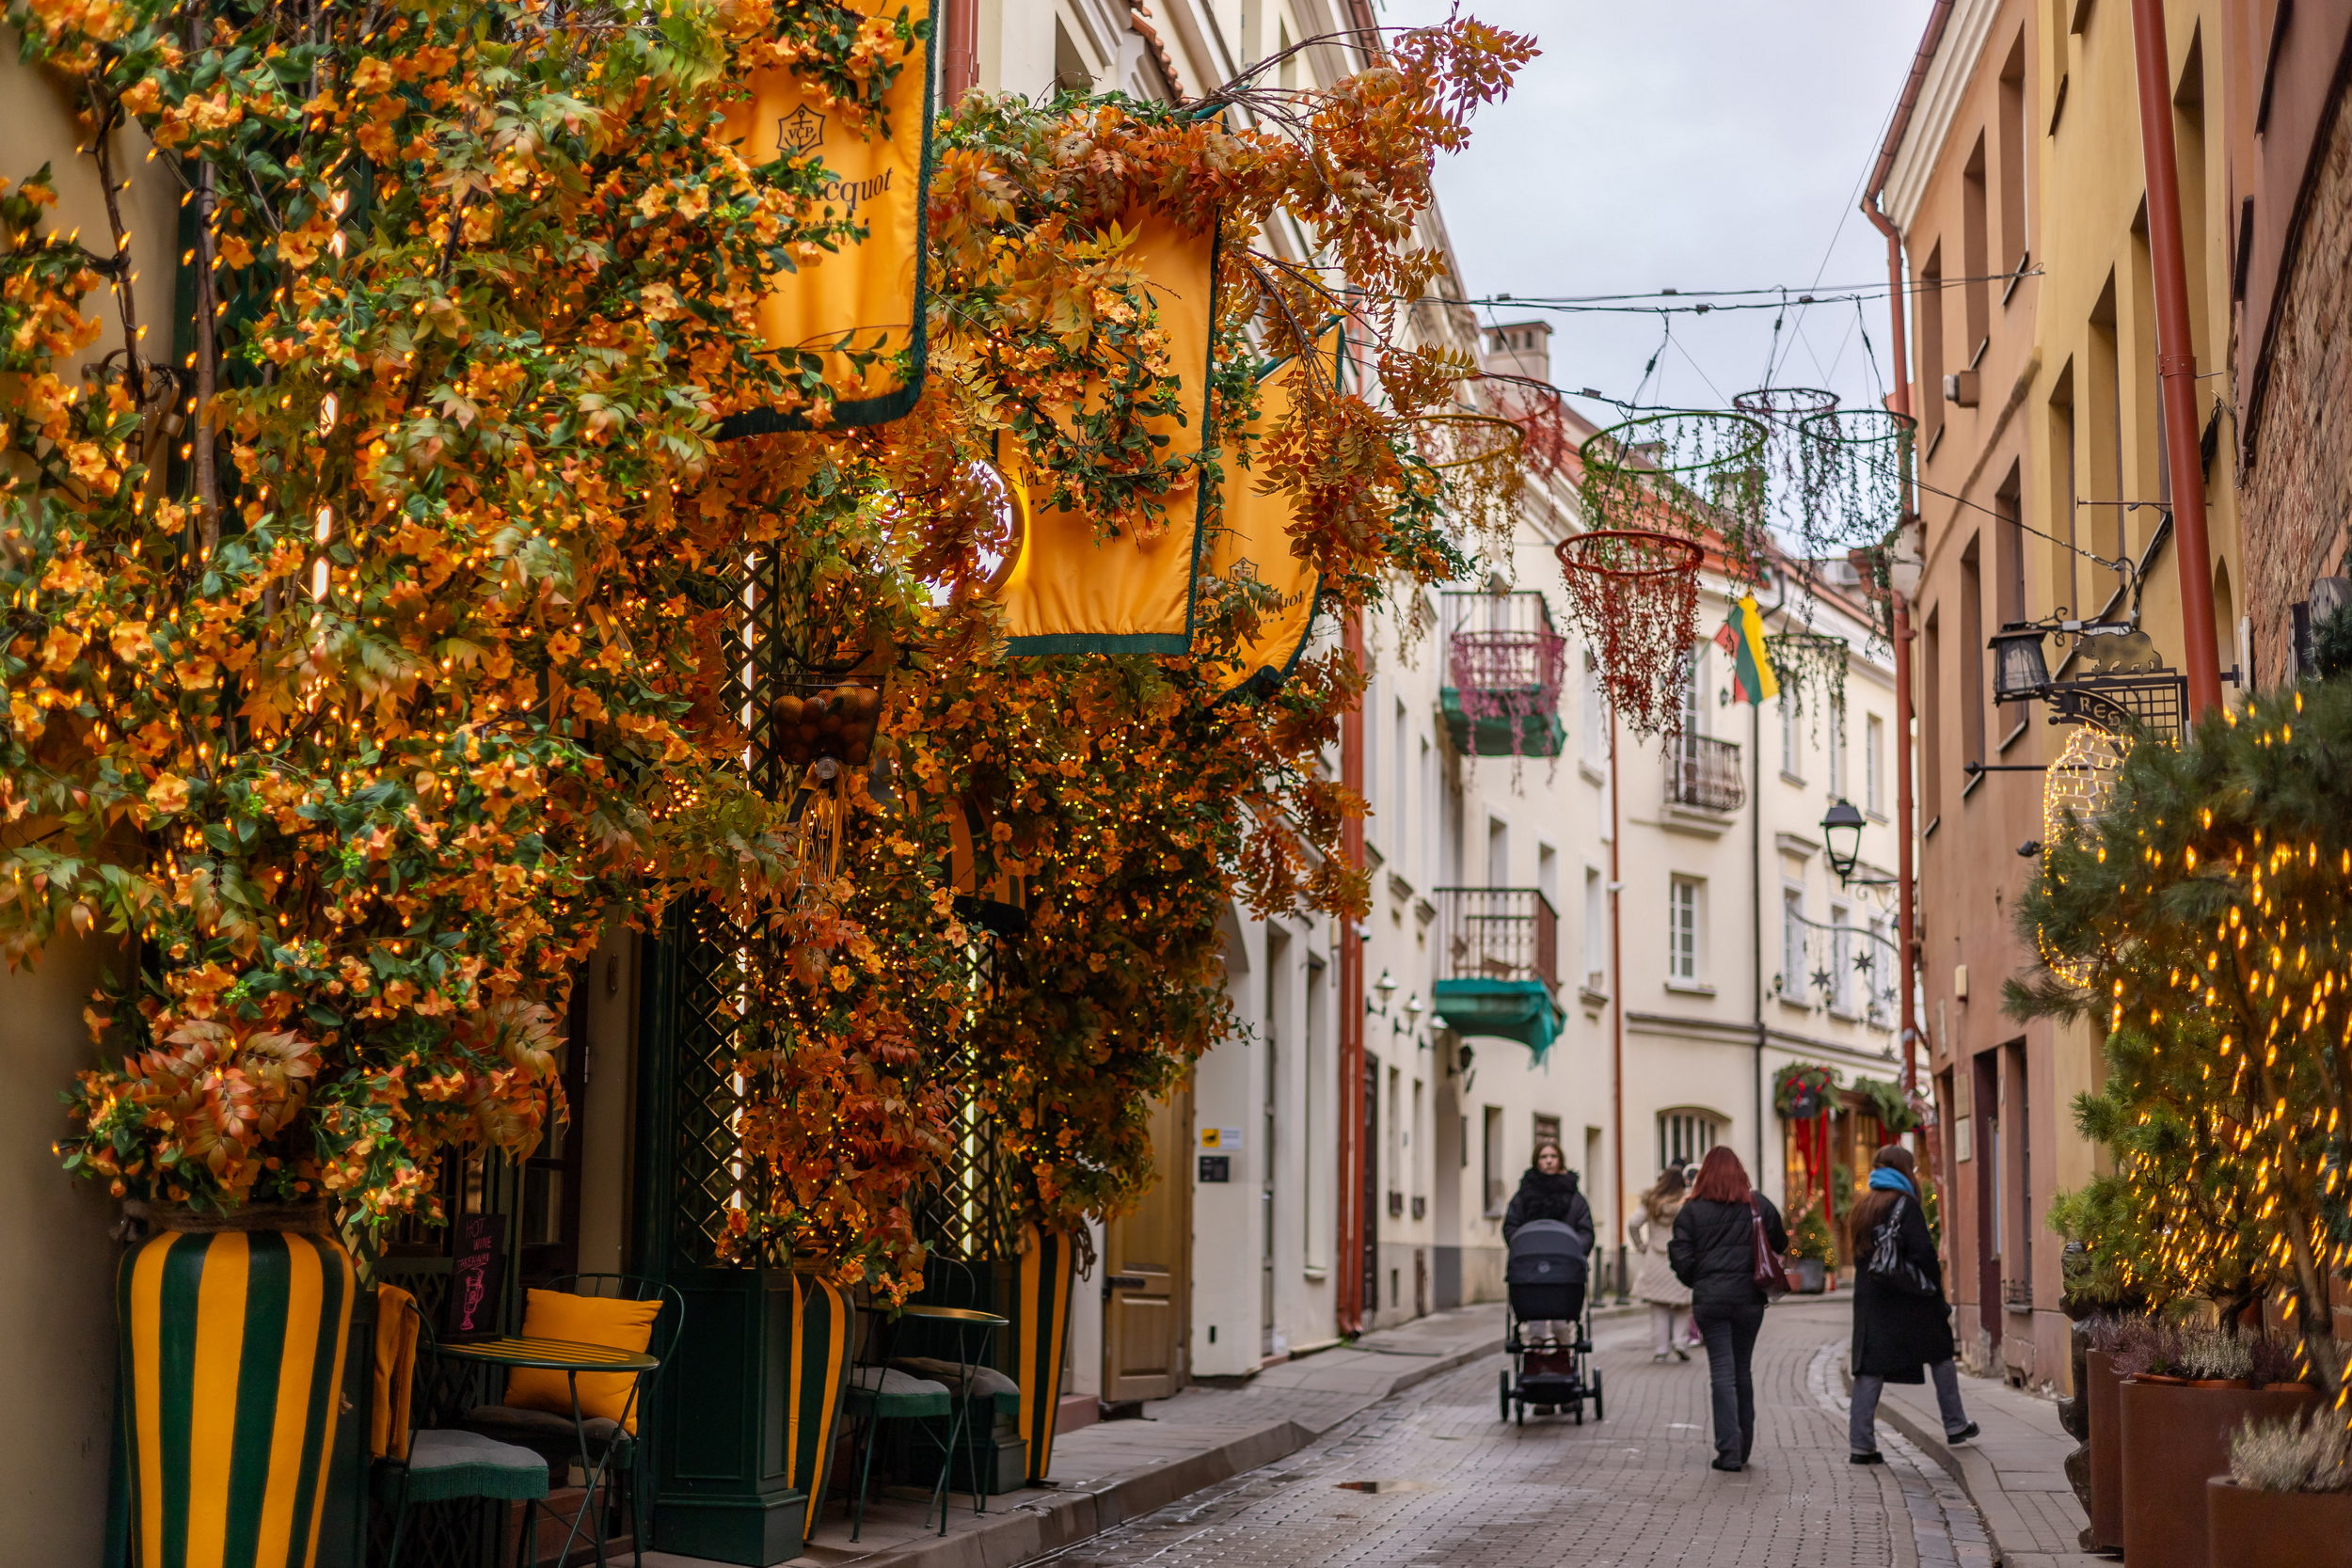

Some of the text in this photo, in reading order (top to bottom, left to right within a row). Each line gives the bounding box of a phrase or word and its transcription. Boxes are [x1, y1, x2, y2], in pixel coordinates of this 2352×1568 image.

[787, 126, 815, 140] VCP
[811, 166, 894, 211] cquot
[2080, 696, 2122, 726] RES
[466, 1217, 486, 1240] HOT
[473, 1235, 492, 1250] WINE
[457, 1252, 489, 1268] TAKEAWAY
